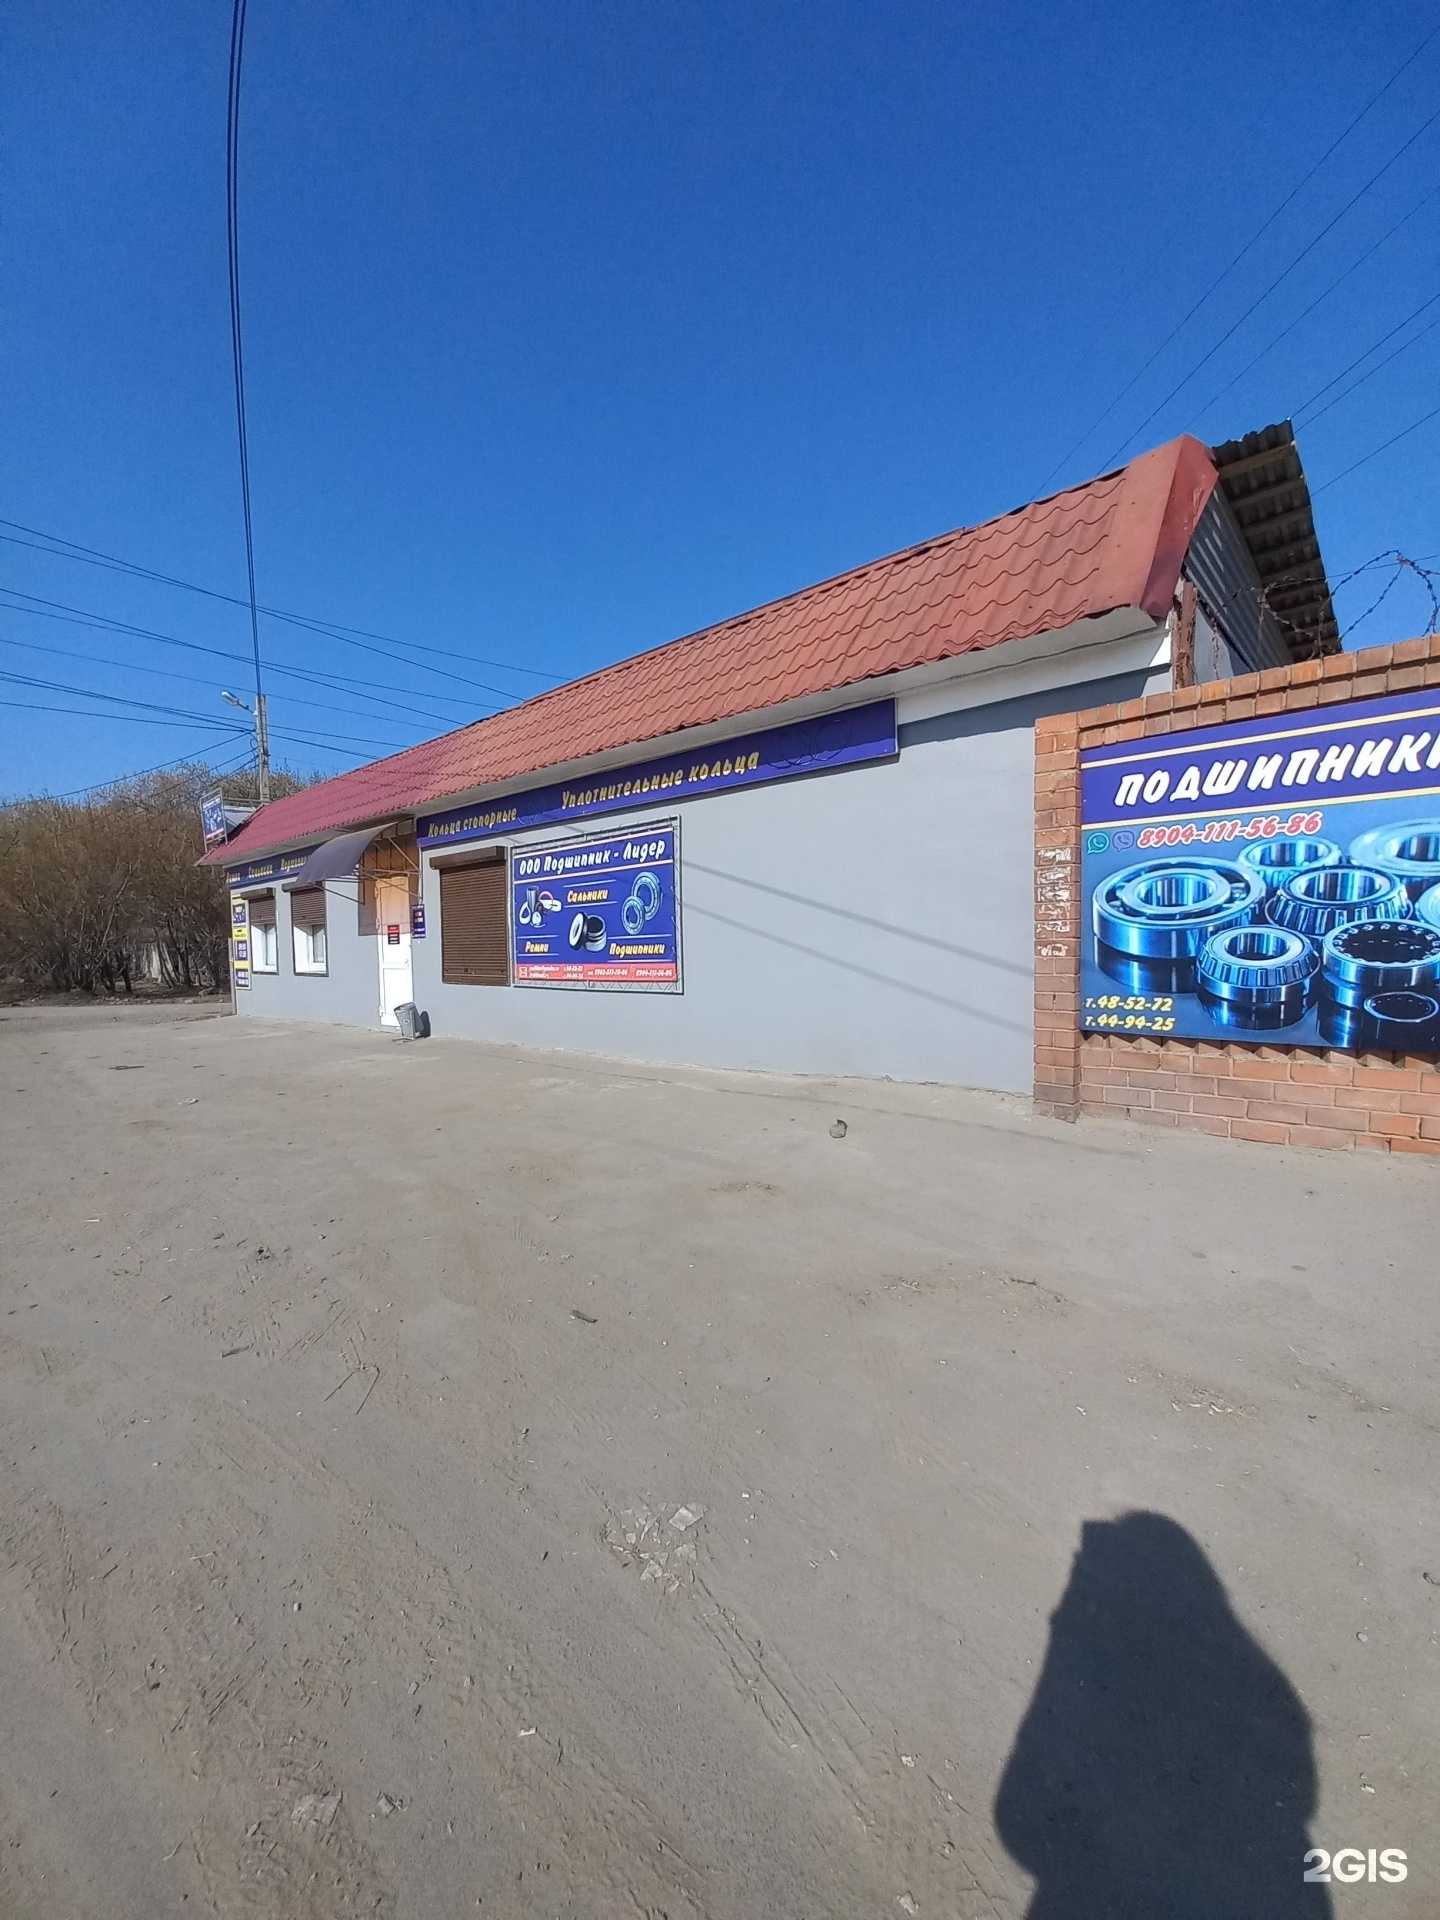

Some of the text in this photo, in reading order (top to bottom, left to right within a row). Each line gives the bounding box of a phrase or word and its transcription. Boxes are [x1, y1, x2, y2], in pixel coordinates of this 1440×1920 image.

[561, 751, 761, 810] Уплотнительные кольца
[428, 807, 518, 838] Кольца стопорные
[1137, 810, 1323, 849] 8904-111-56-86
[519, 857, 541, 876] ООО
[543, 849, 610, 875] Подшипник
[622, 840, 666, 863] Лидер
[567, 888, 609, 903] Сальники
[609, 942, 665, 959] Подшипники
